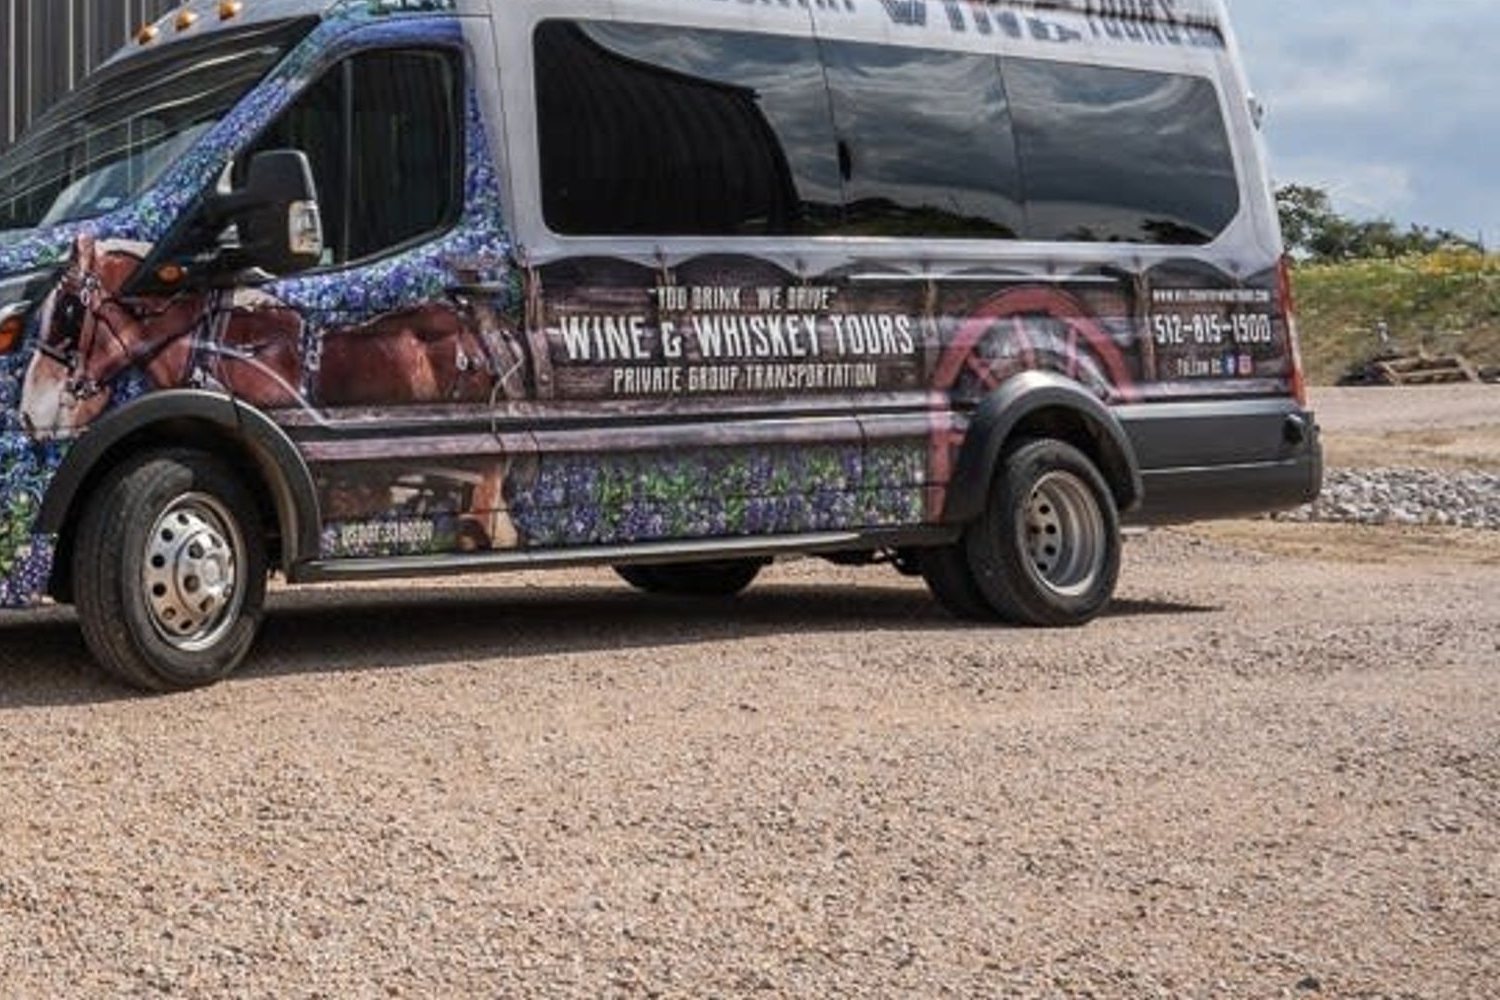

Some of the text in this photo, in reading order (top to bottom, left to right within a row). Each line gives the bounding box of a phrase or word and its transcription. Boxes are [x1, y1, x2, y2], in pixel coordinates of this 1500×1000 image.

[559, 313, 916, 360] WINE & WHISKEY TOURS
[613, 362, 878, 393] PRIVATE GROUP TRANSPORTATION
